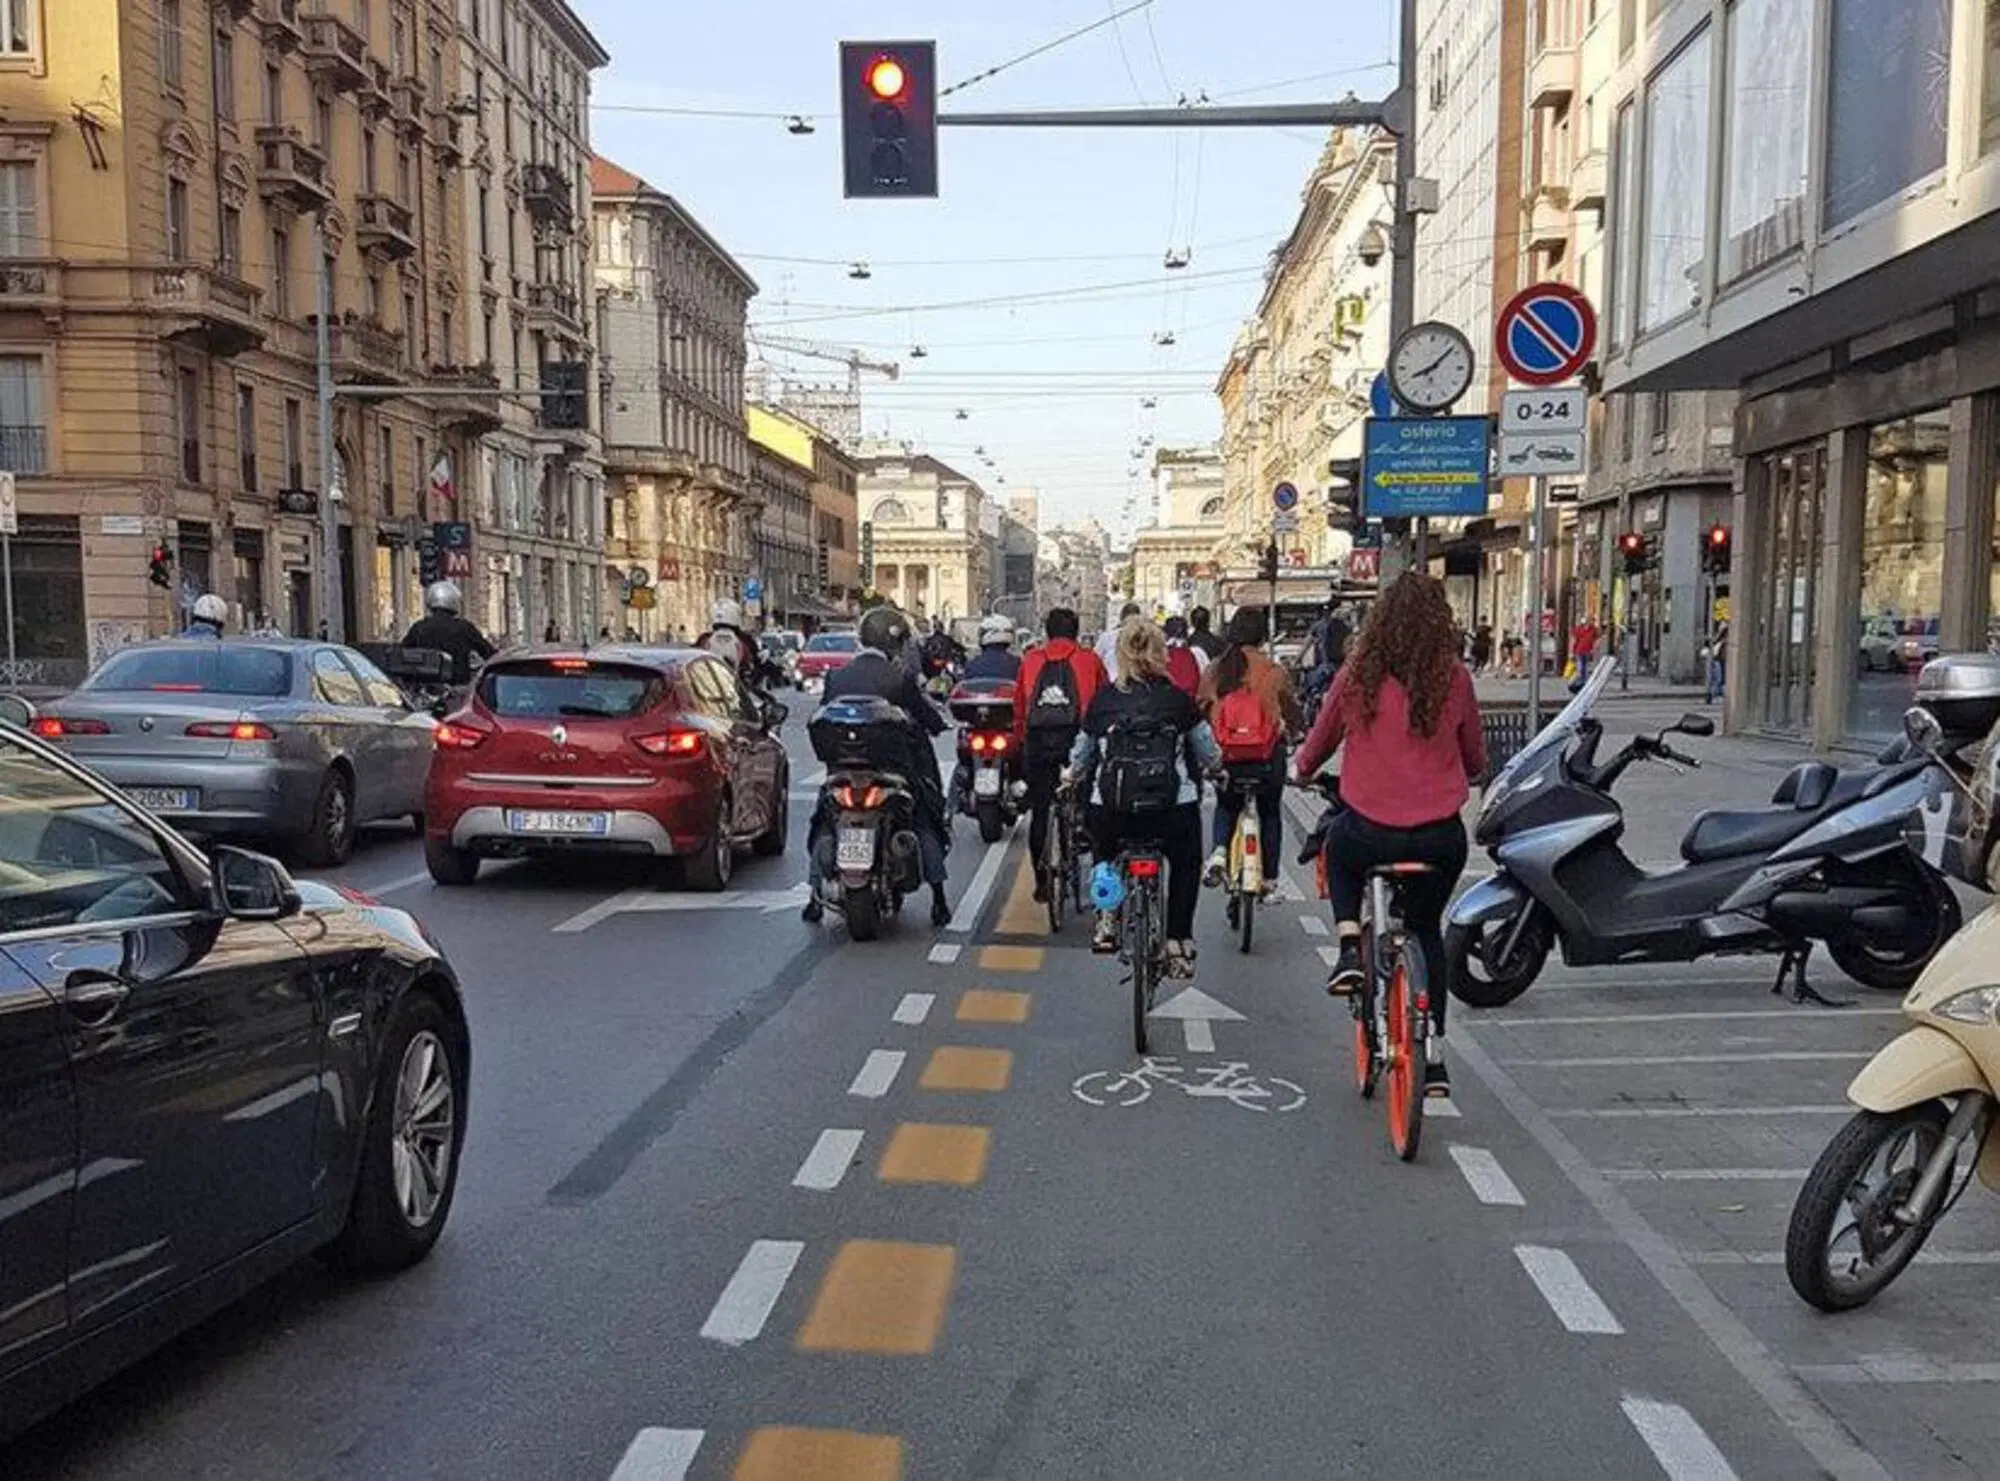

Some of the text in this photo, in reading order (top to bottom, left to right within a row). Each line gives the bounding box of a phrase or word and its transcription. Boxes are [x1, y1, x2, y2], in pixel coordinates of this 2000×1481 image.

[1517, 401, 1569, 420] 0-24
[447, 551, 470, 572] M
[1352, 555, 1376, 575] M
